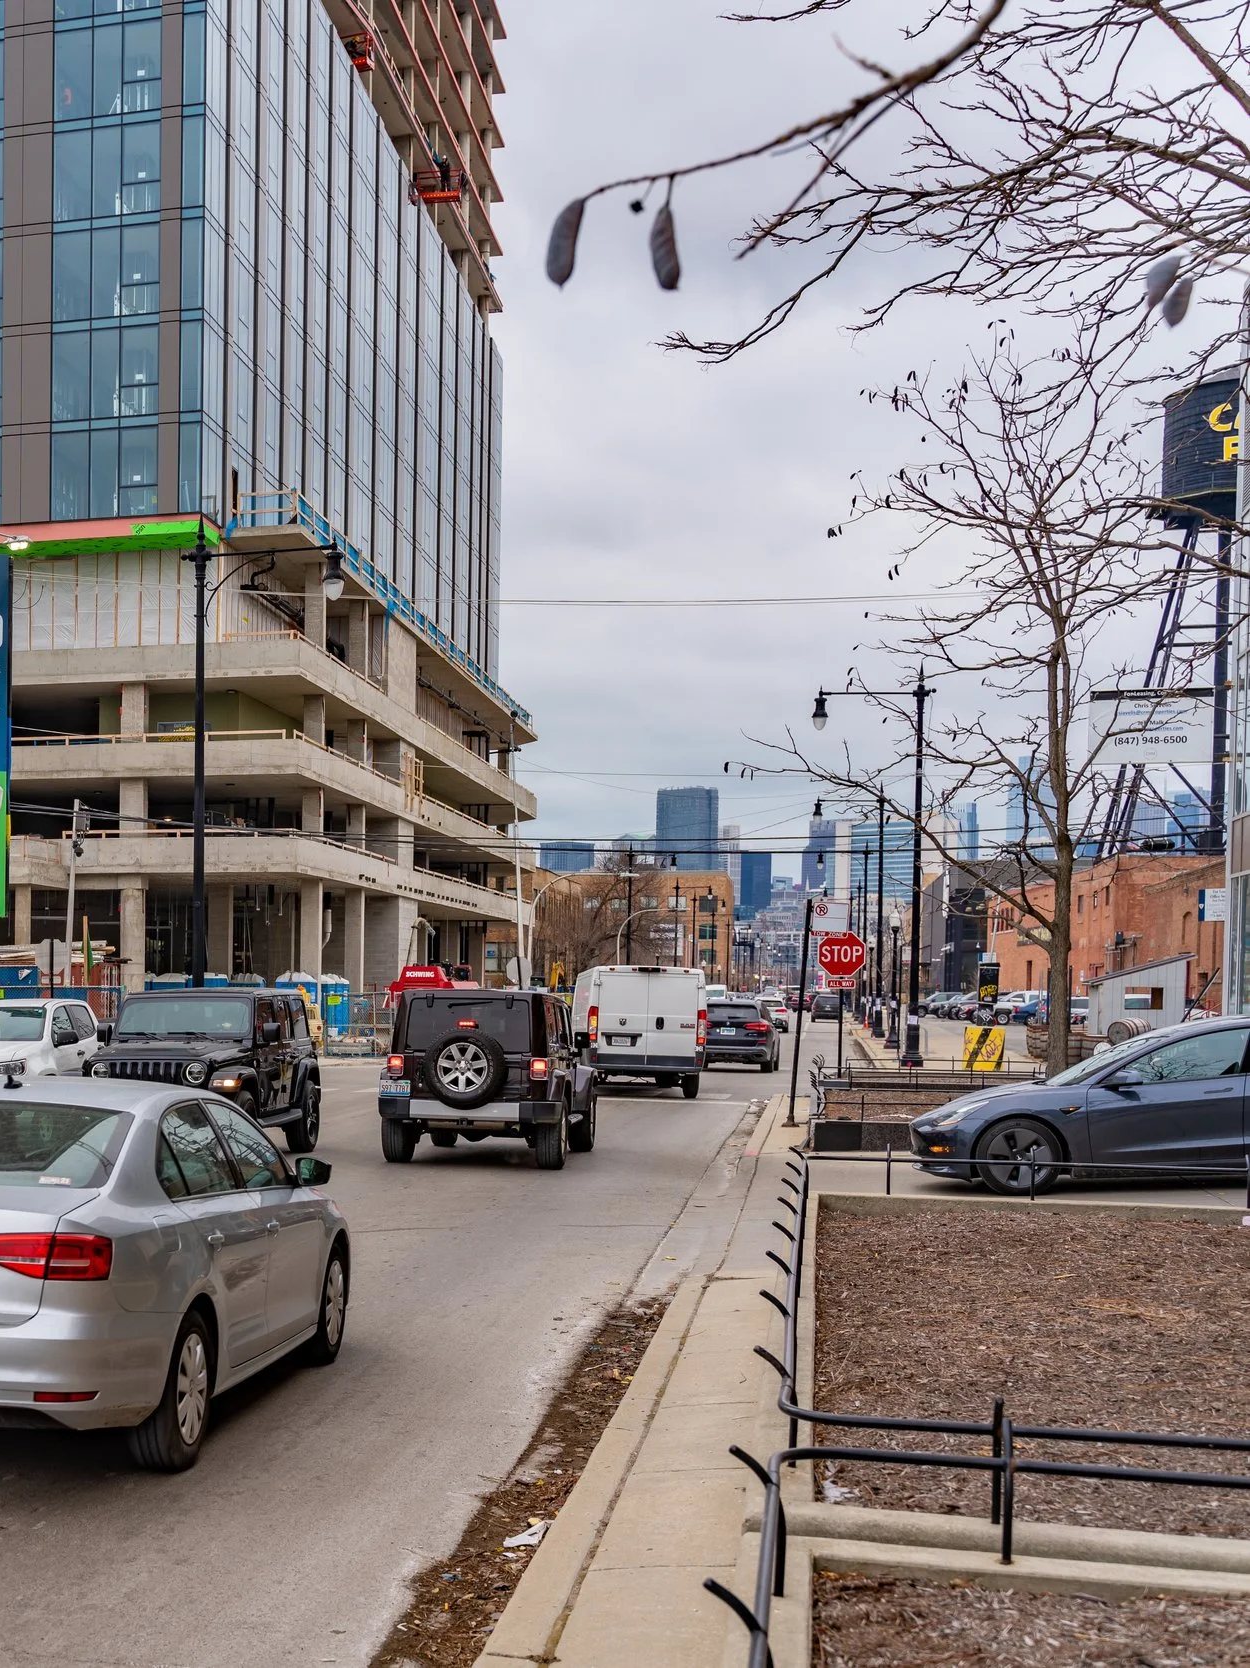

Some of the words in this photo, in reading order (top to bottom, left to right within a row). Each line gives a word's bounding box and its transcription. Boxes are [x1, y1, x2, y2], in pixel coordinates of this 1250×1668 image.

[1114, 737, 1139, 747] (847)
[1141, 735, 1188, 745] 948-6500
[821, 945, 862, 962] STOP
